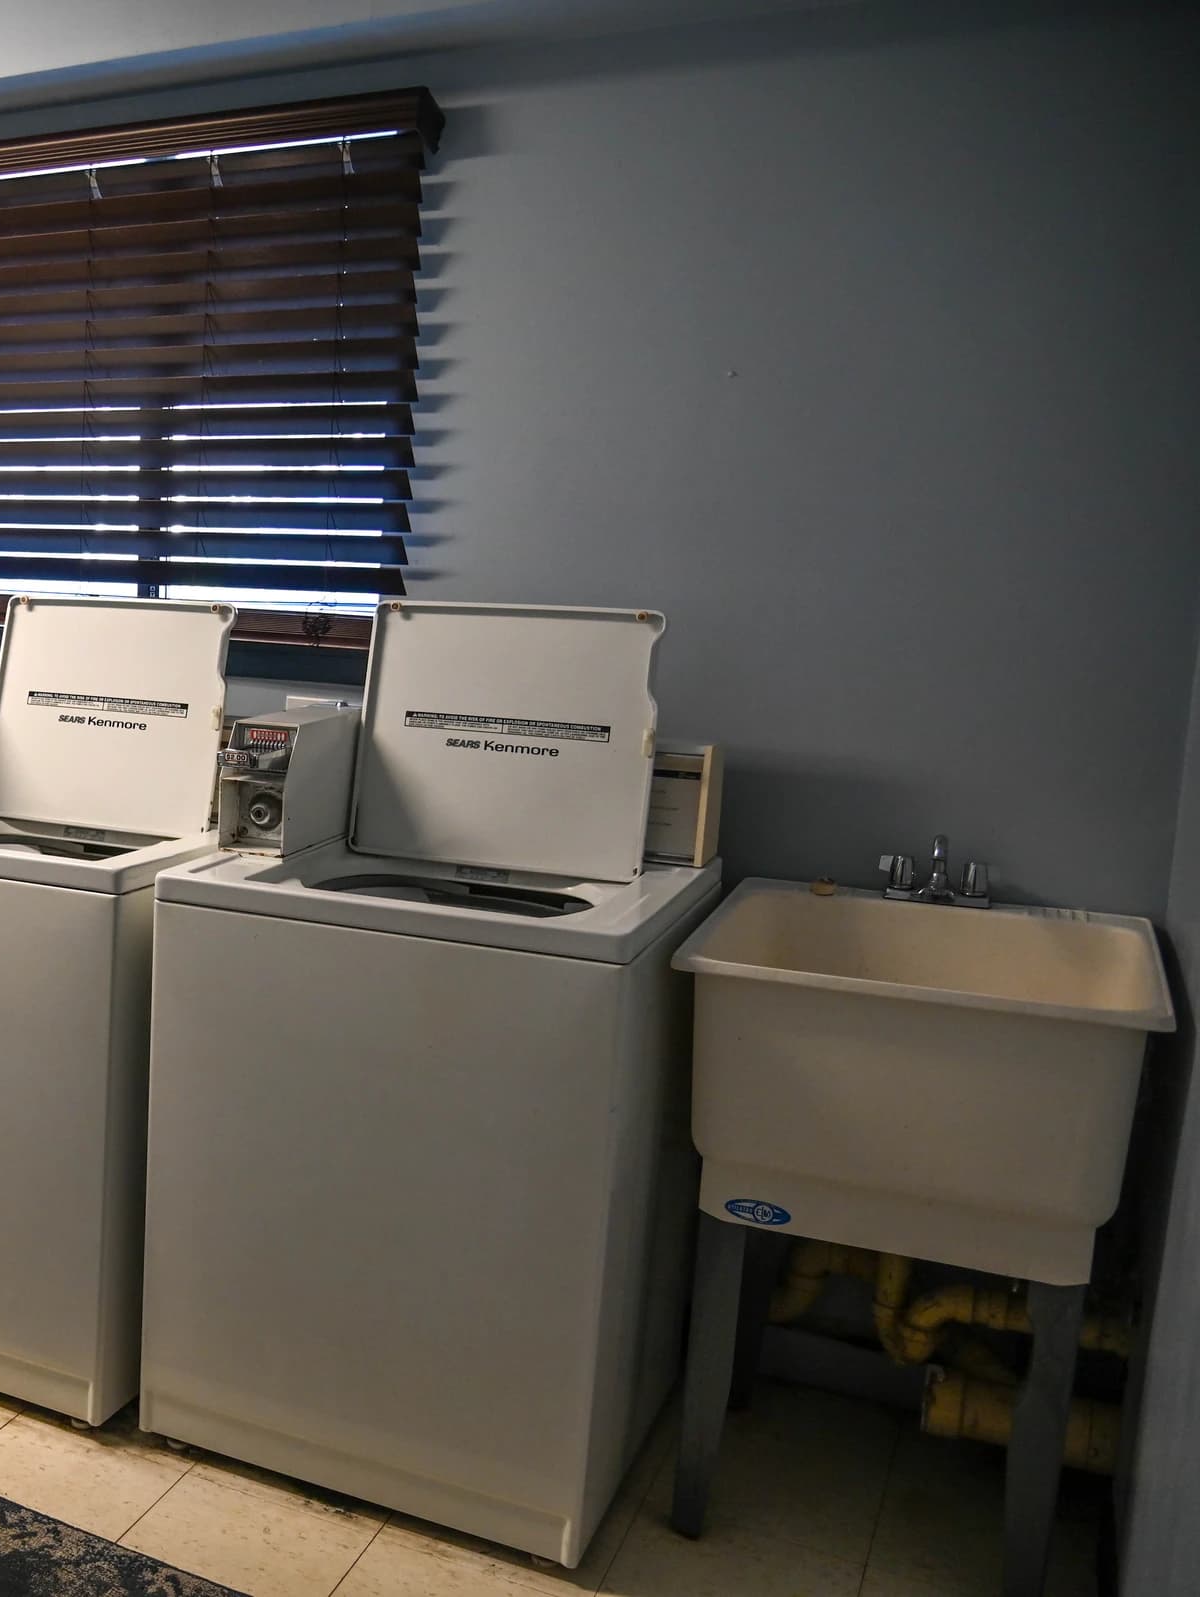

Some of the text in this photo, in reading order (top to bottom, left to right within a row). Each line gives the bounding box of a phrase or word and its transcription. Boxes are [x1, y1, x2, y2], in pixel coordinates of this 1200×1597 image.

[58, 714, 147, 731] SEARS Kenmore
[536, 721, 569, 729] SPONTANEOUS
[570, 723, 602, 731] COMBUSTION
[446, 738, 560, 757] SEARS Kenmore
